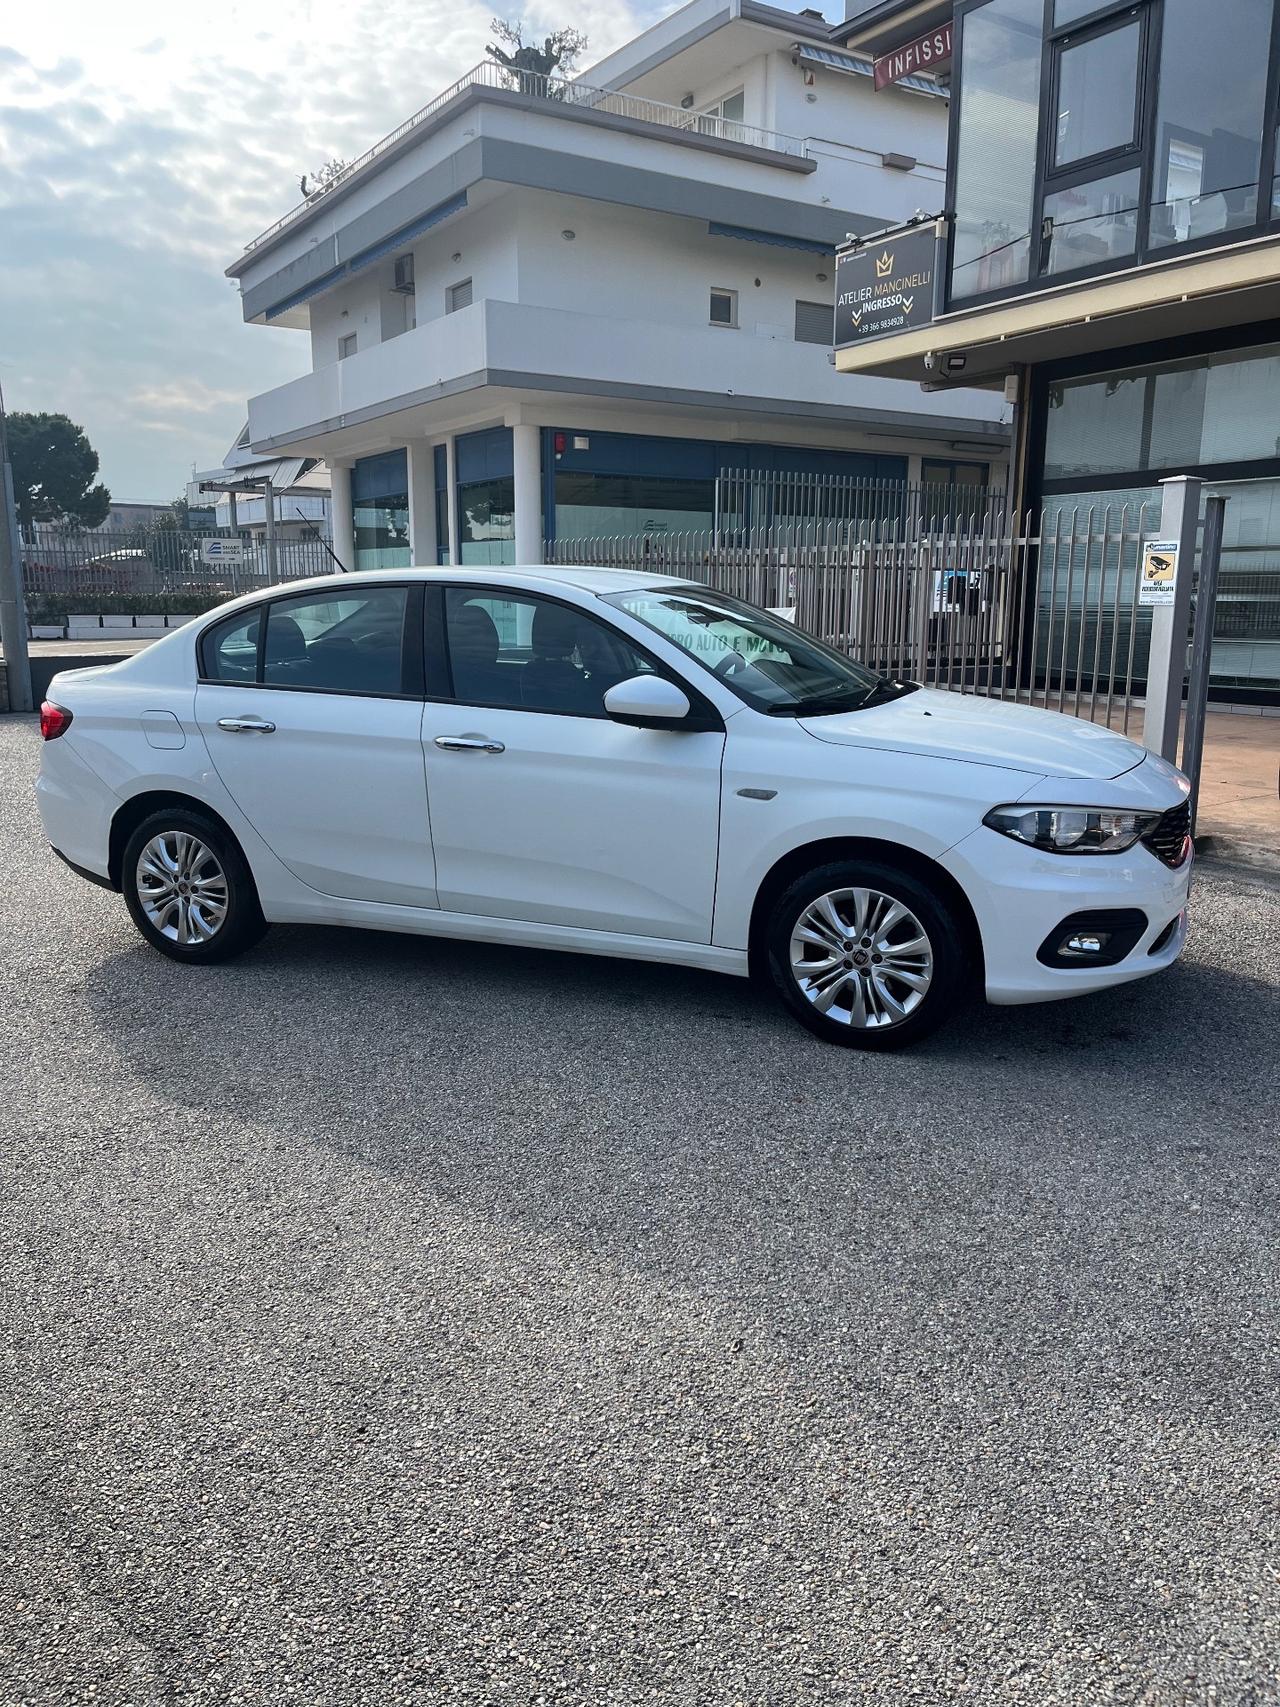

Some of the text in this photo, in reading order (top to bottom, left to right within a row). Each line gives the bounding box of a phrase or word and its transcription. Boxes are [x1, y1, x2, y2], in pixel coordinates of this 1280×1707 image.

[888, 30, 951, 79] INFISSI
[838, 271, 931, 306] ATELIER MANCINELLI
[862, 294, 903, 313] INGRESSO
[858, 324, 869, 333] +39
[697, 634, 728, 651] AUTO
[733, 636, 741, 652] E
